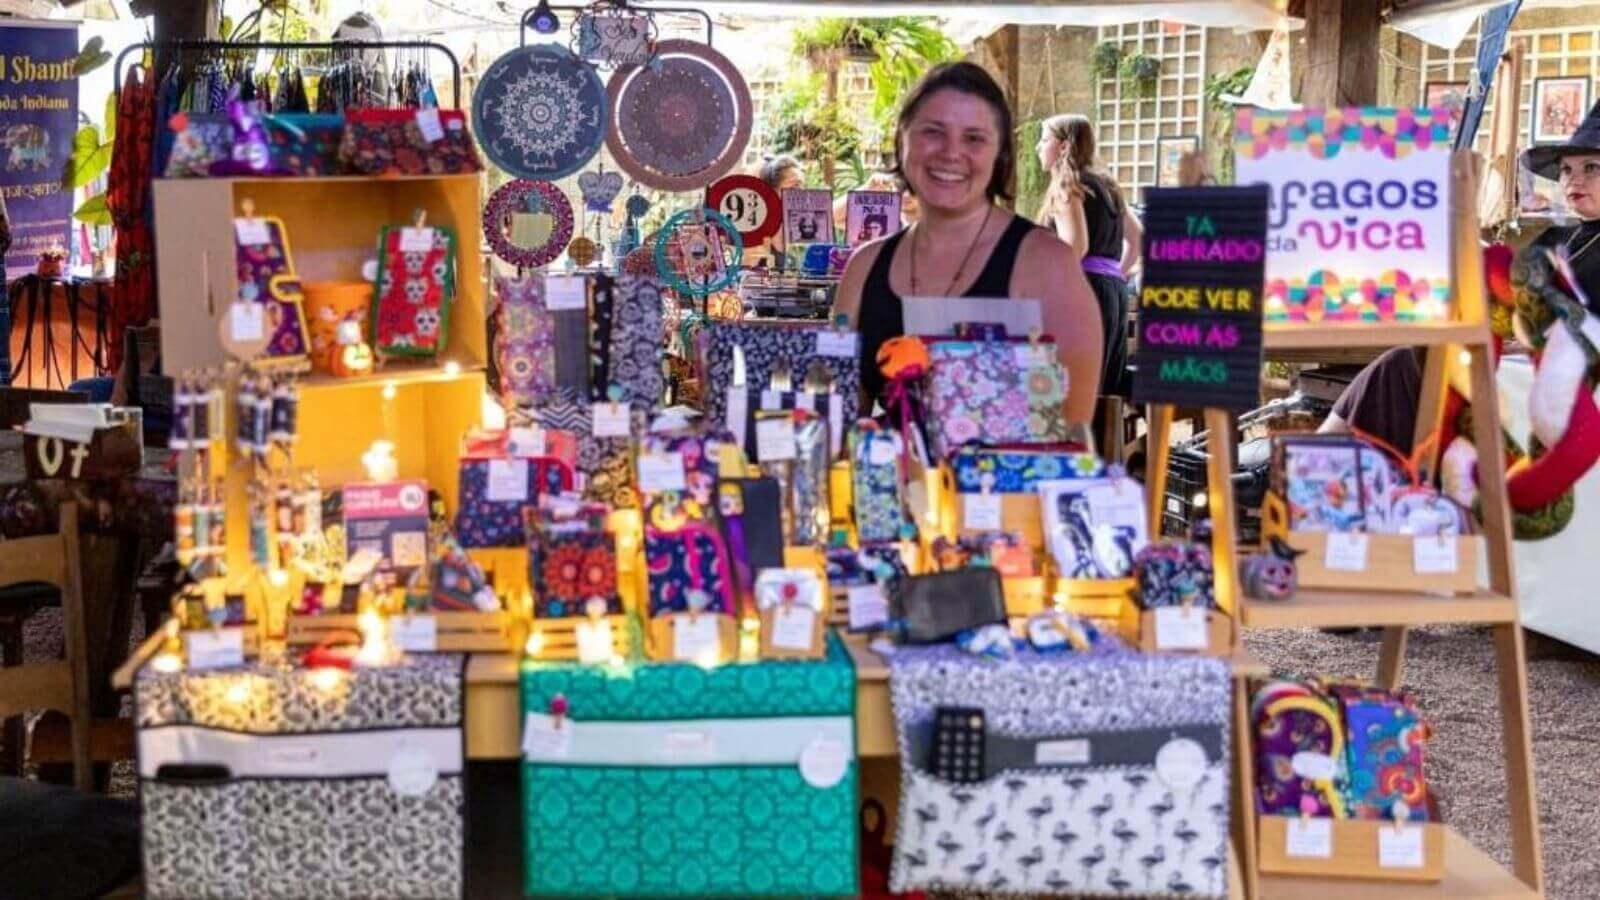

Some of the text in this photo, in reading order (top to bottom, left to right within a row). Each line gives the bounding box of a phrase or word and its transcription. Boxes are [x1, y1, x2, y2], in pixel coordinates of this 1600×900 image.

[20, 94, 69, 109] Indiana
[1149, 239, 1262, 261] LIBERADO
[1143, 287, 1252, 311] PODE VER
[1145, 323, 1200, 345] COM
[1160, 357, 1227, 383] MÃOS
